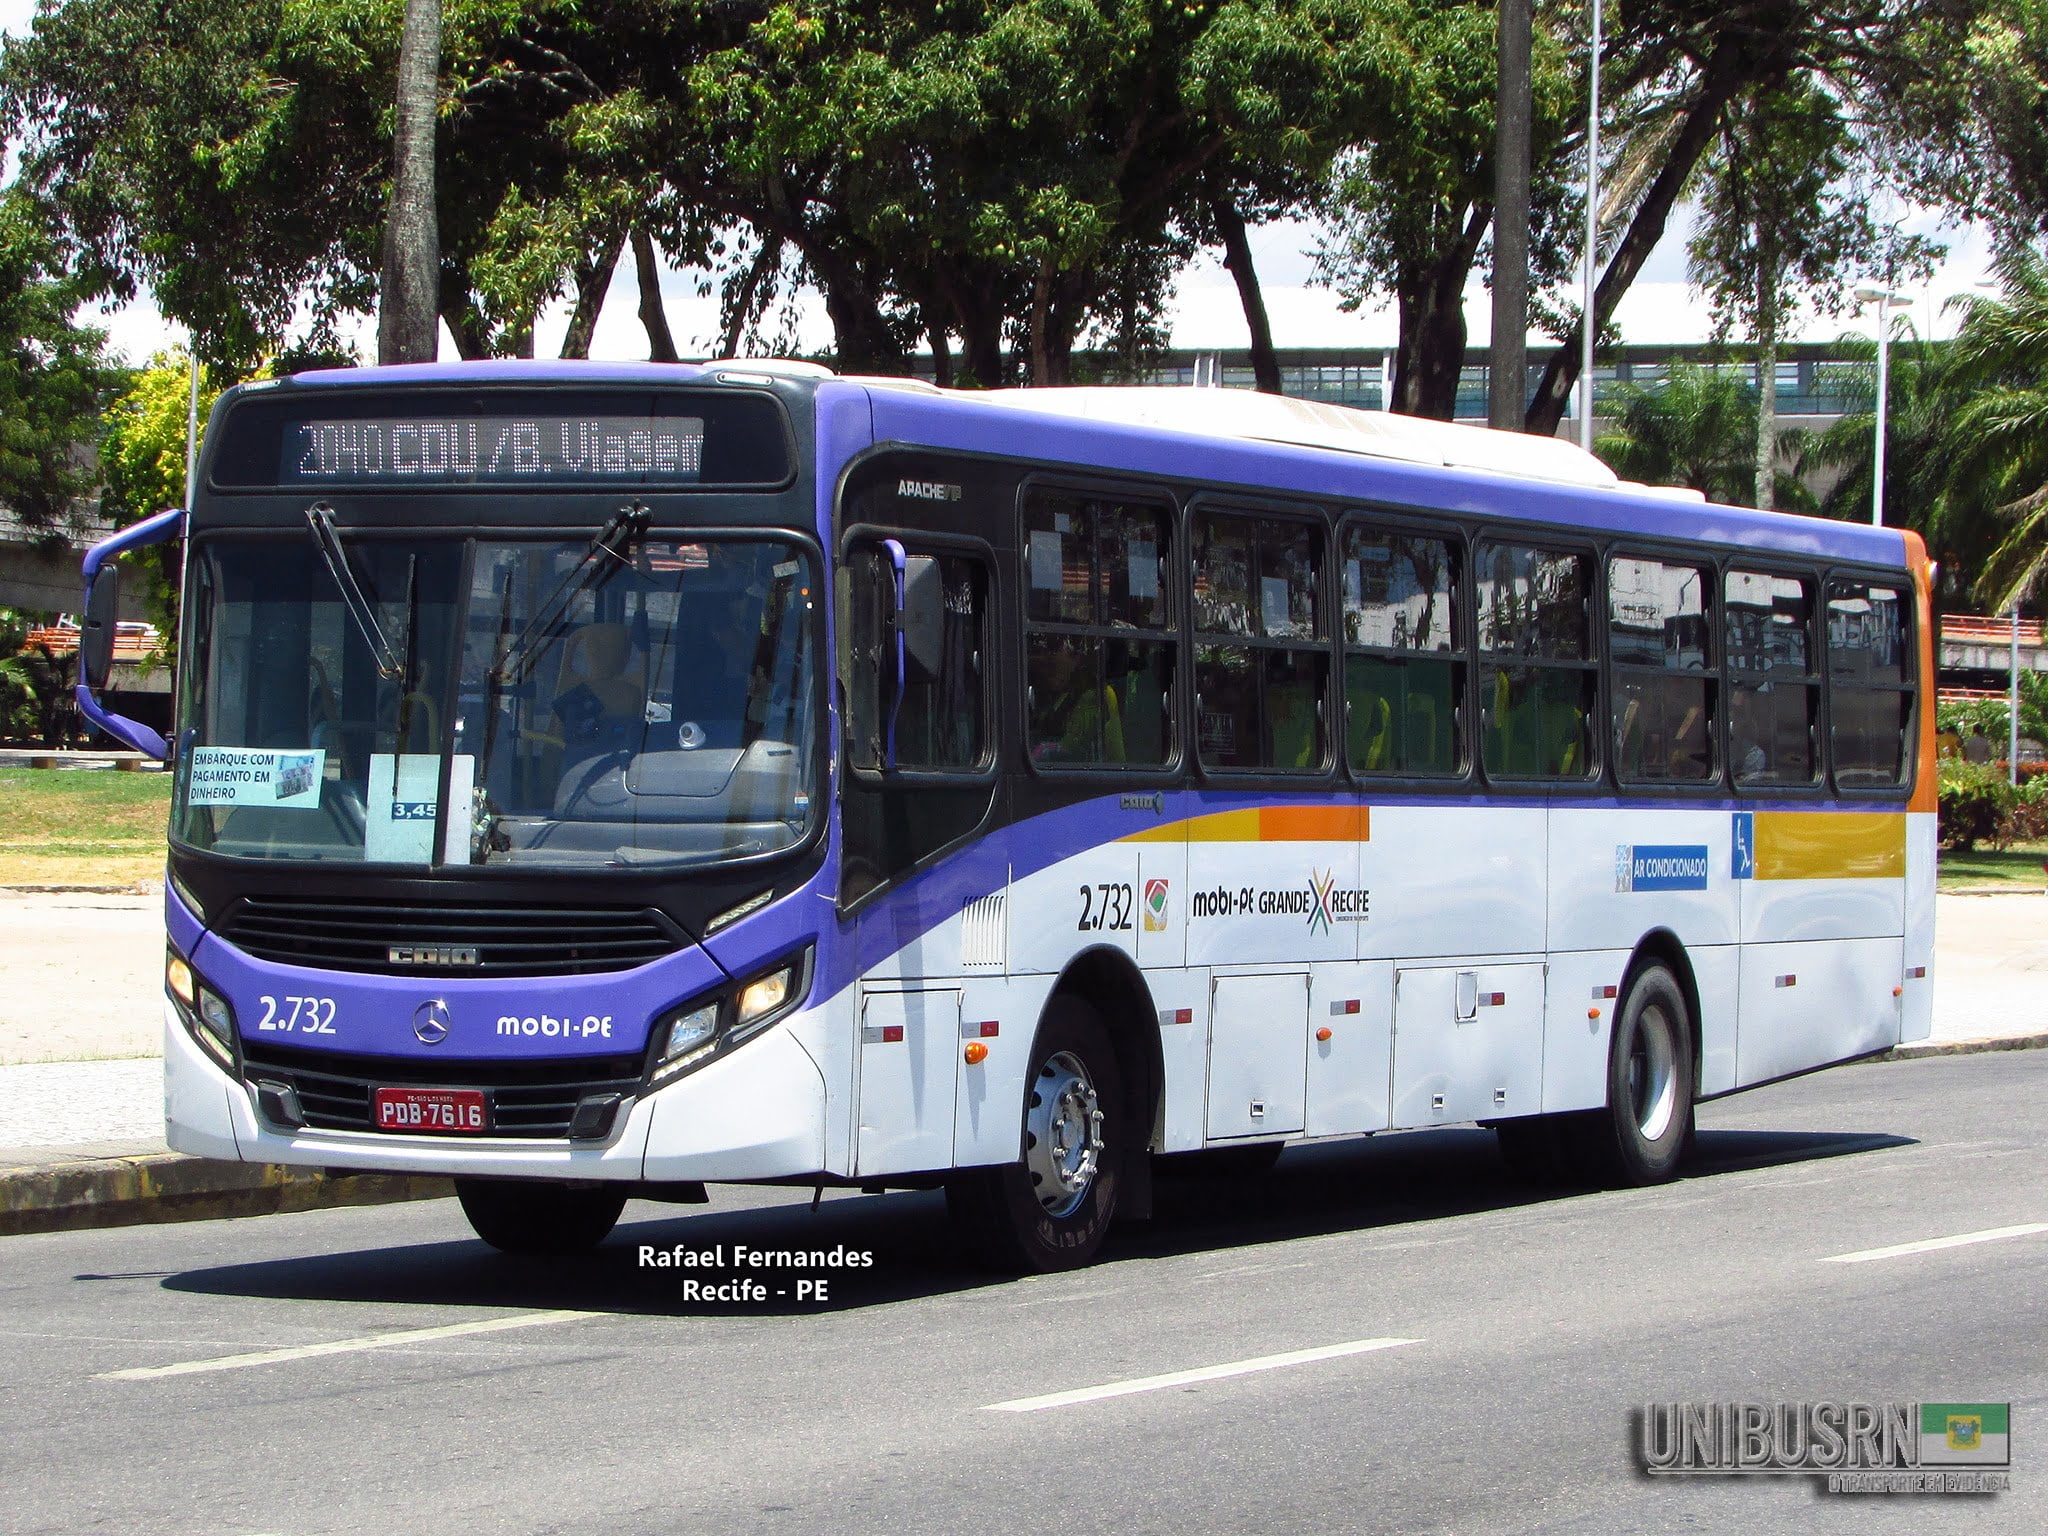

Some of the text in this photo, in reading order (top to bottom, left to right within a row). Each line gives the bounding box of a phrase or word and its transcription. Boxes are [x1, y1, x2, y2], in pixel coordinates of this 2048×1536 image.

[298, 424, 383, 475] 2040
[898, 480, 944, 500] APACHE
[194, 754, 275, 766] EMBARQUE COM
[192, 771, 270, 783] PAGAMENTO EM
[191, 787, 236, 799] DINHEIRO
[395, 804, 437, 818] 3,45
[1633, 858, 1706, 878] AR CONDICIONADO
[1078, 883, 1133, 931] 2.732
[1259, 889, 1370, 914] GRANDE RECIFE
[389, 947, 477, 966] CAIO
[258, 996, 337, 1034] 2.732
[382, 1102, 481, 1126] PDB-7616
